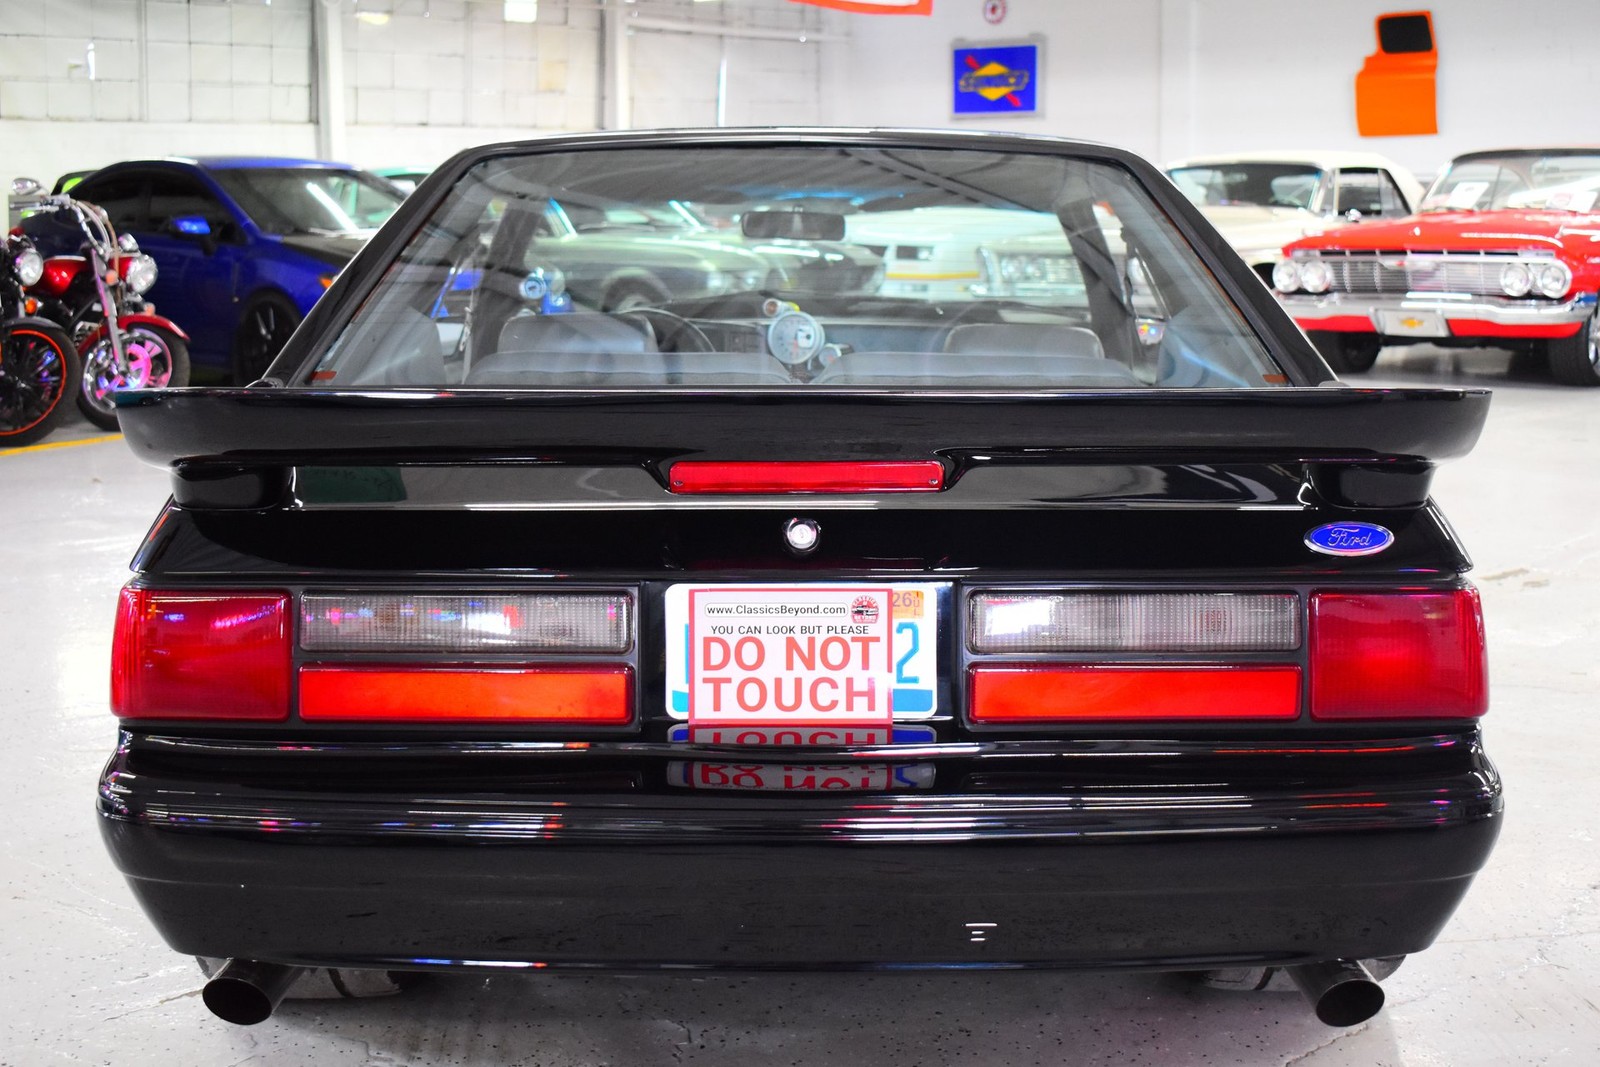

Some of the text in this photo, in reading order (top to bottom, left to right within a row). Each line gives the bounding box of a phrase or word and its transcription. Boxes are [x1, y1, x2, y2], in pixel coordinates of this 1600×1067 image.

[1327, 527, 1373, 546] Ford
[707, 604, 846, 616] www.ClassicsBeyond.com
[711, 625, 869, 635] YOU CAN LOOK BUT PLEASE
[702, 636, 881, 671] DO NOT
[702, 677, 876, 712] TOUCH
